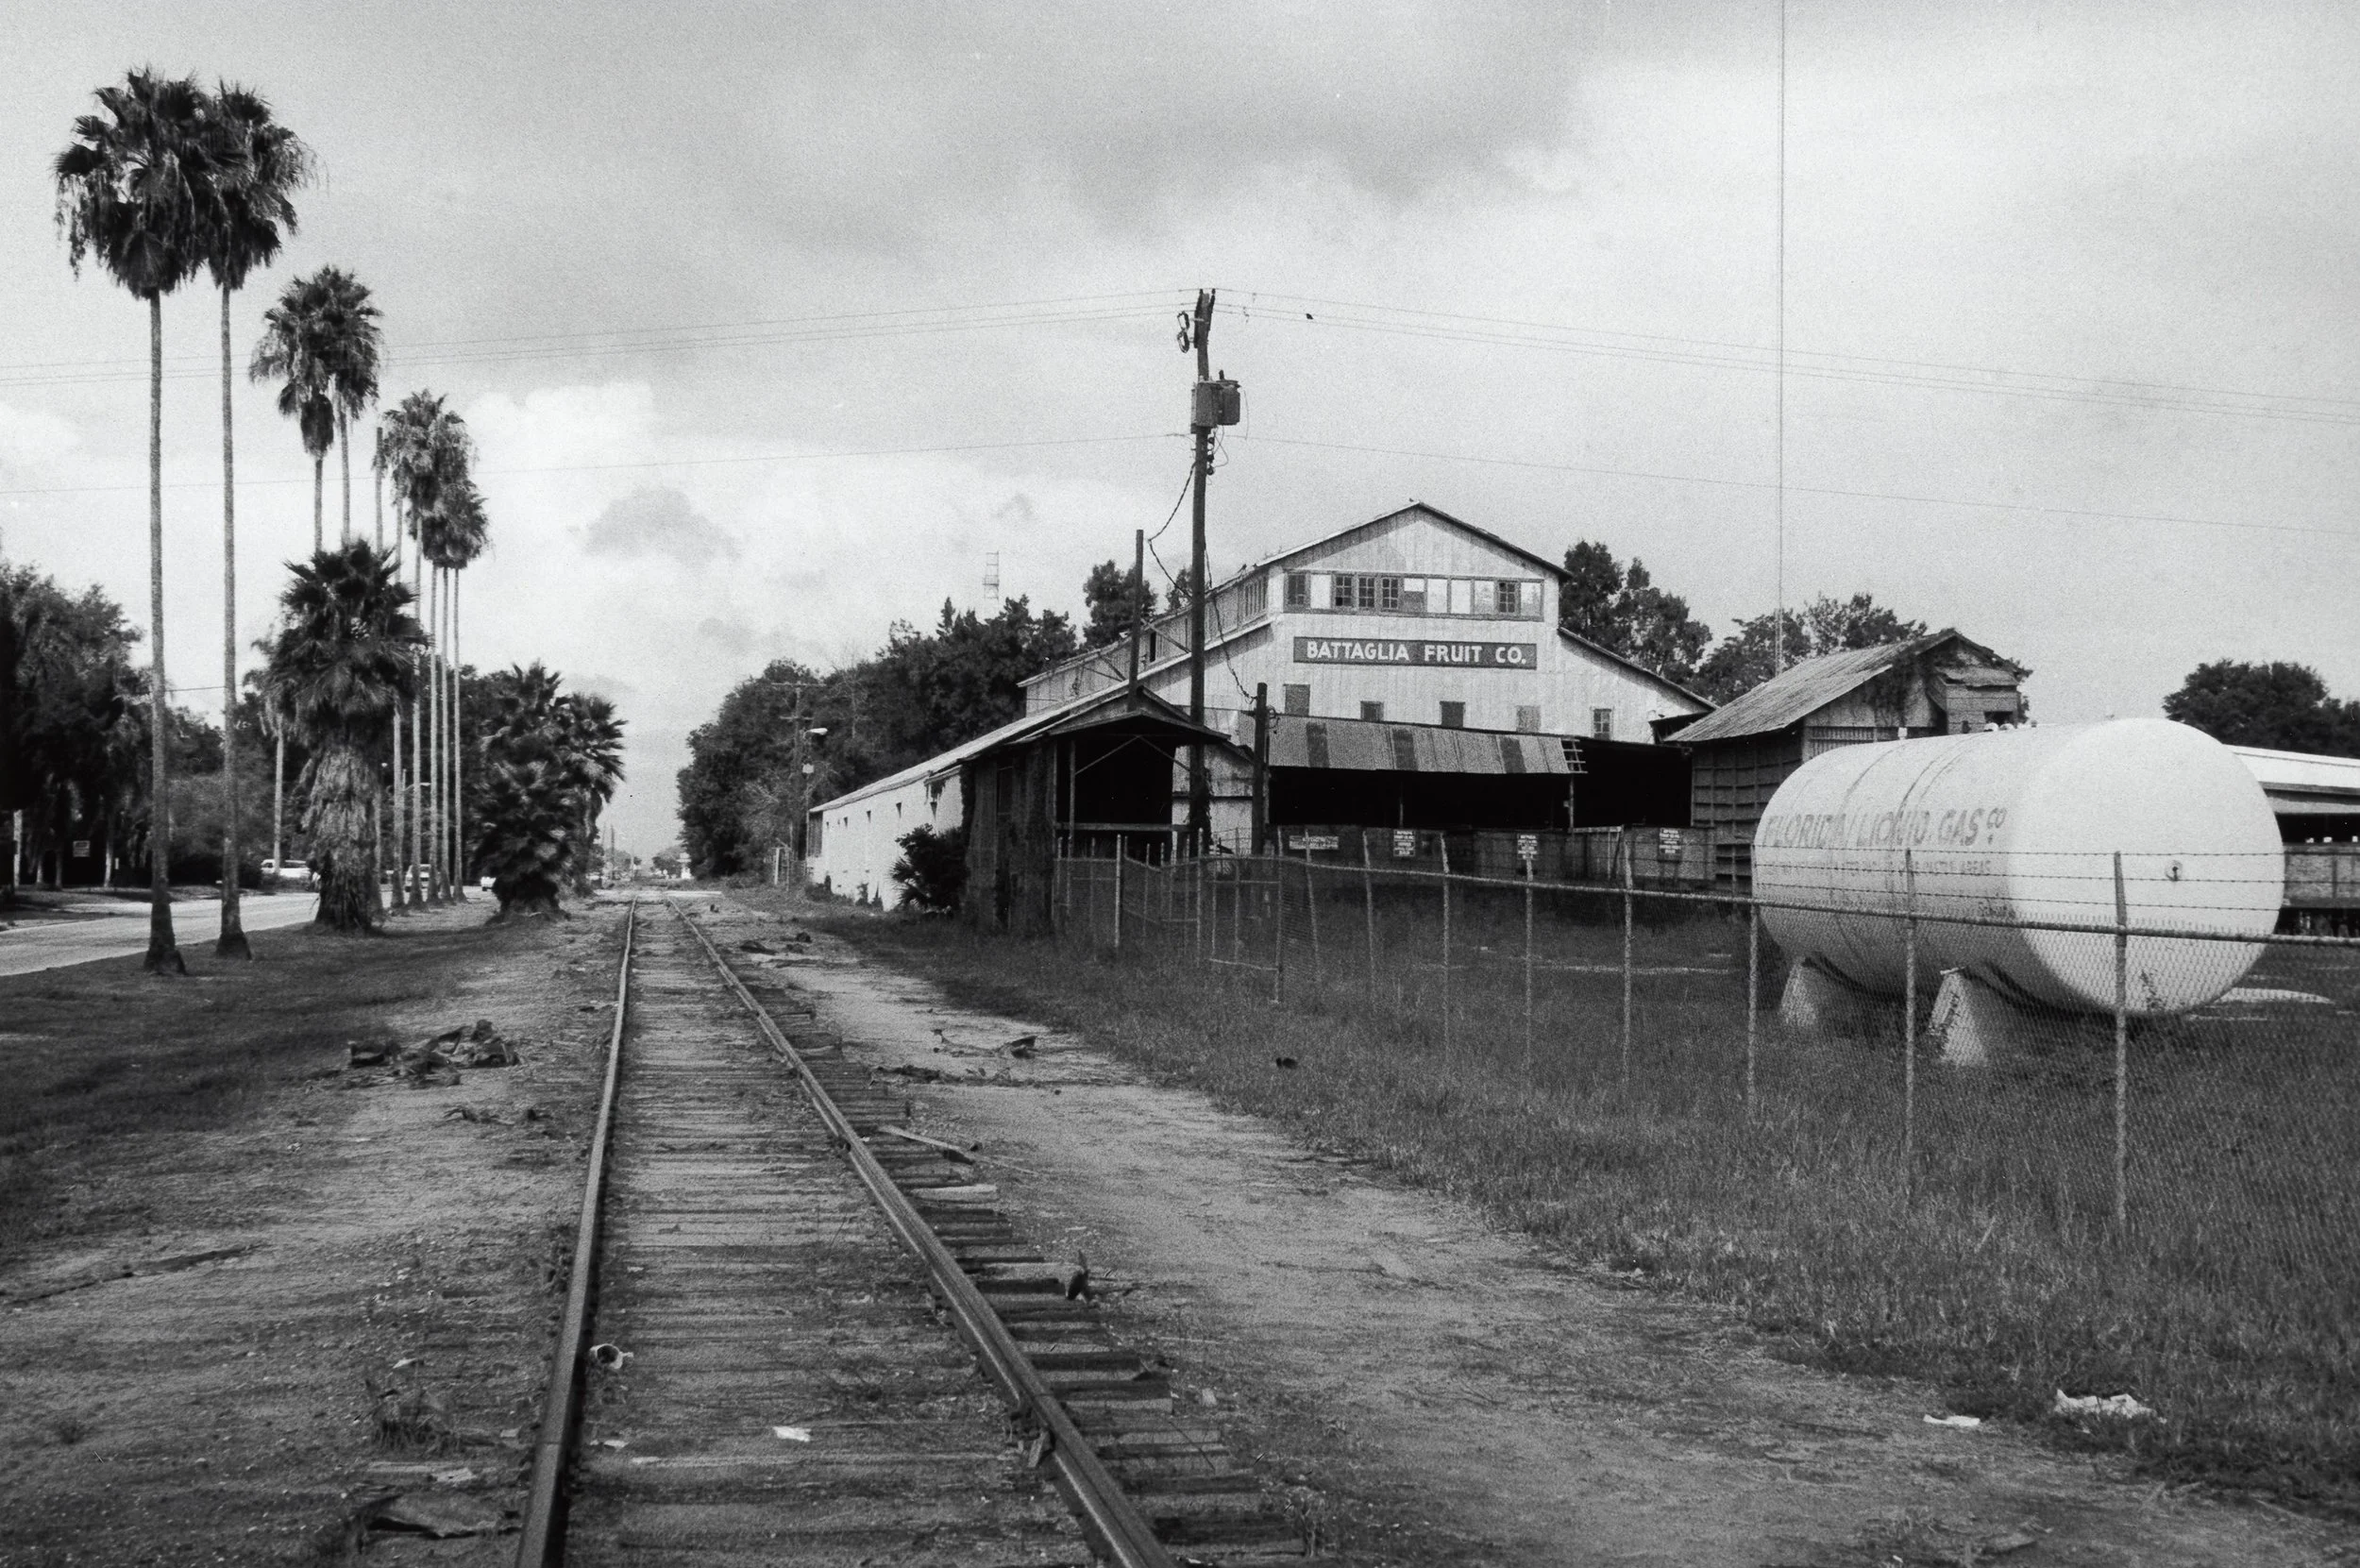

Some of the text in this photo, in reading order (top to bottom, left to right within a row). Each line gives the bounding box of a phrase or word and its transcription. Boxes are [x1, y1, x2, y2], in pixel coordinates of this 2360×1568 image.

[1306, 641, 1526, 665] BATTAGLIA FRUIT CO.
[1938, 807, 1983, 847] GAS
